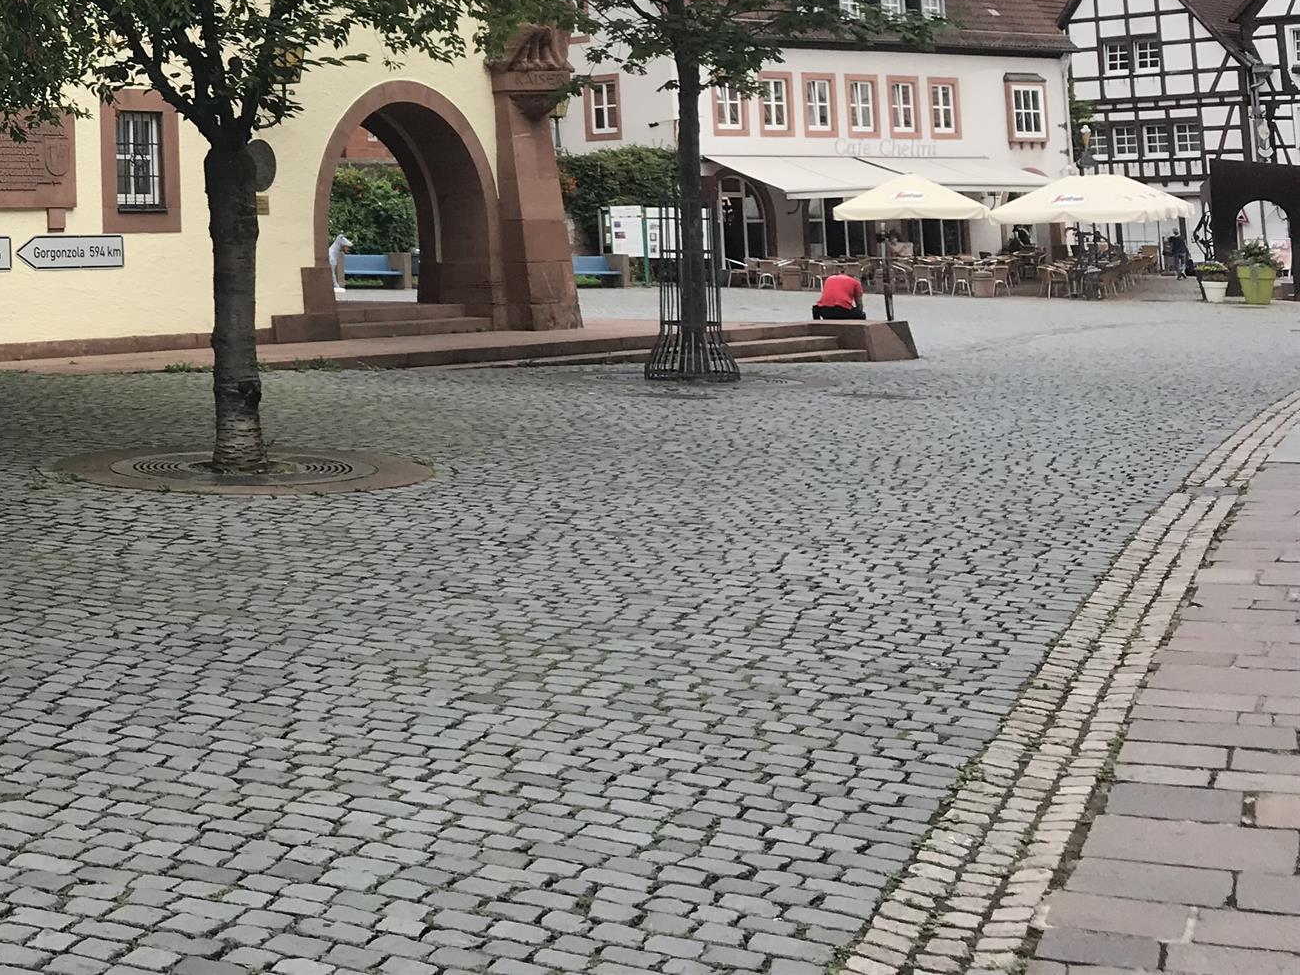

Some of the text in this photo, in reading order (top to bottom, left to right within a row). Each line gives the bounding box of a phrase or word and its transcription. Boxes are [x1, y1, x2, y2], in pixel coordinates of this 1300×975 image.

[879, 138, 937, 157] Chelini
[33, 245, 121, 261] Gorgonzola 594 km
